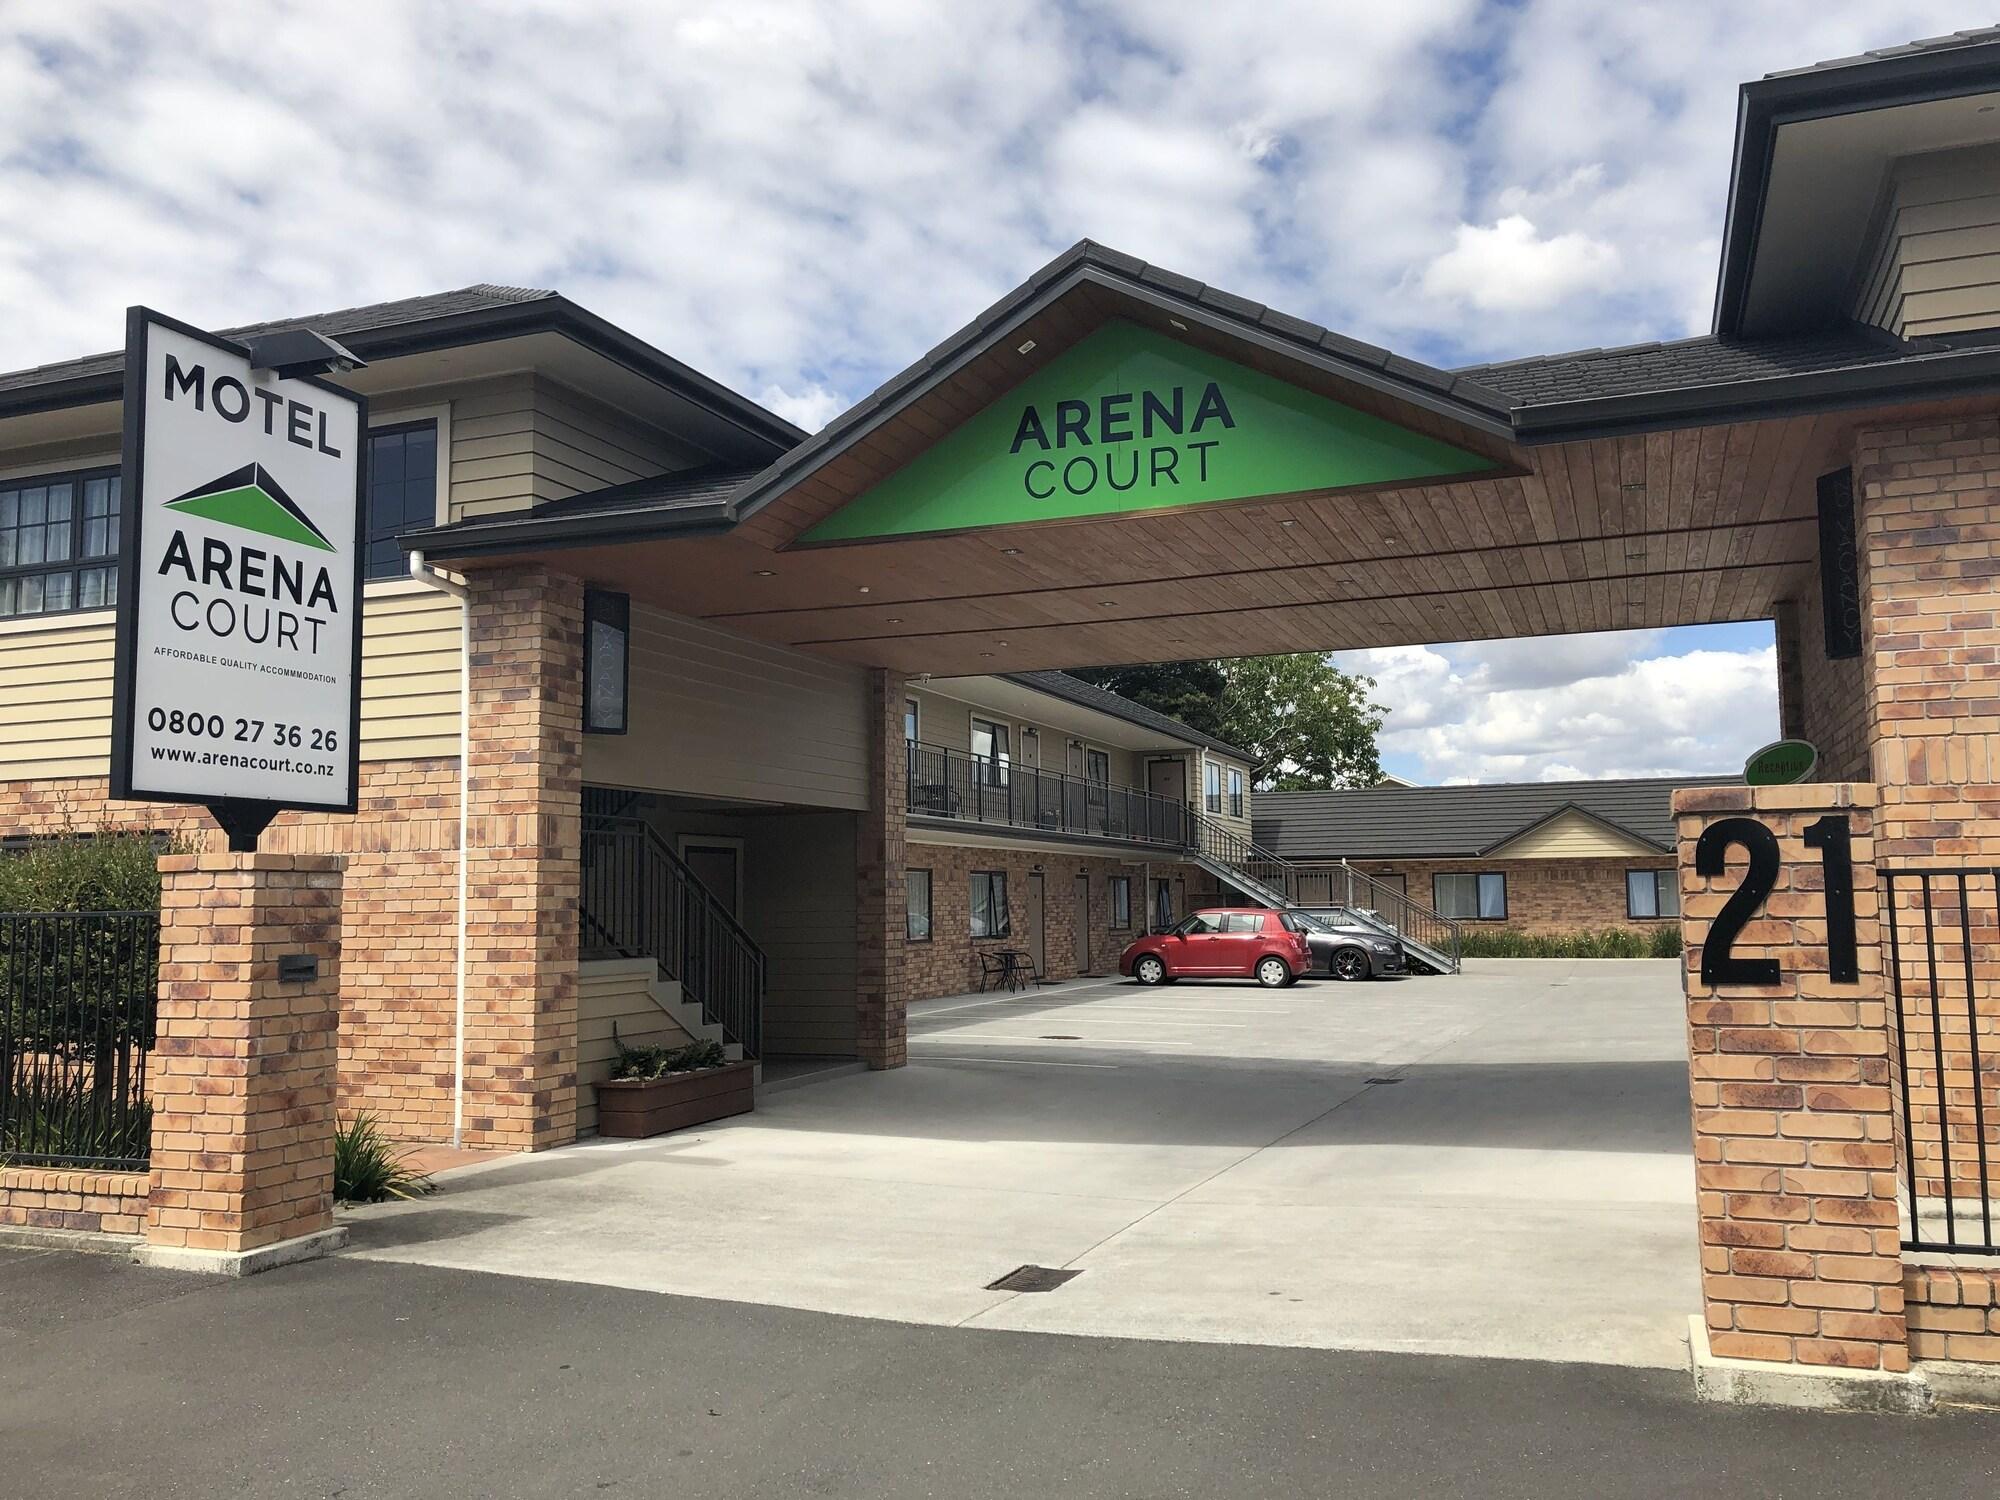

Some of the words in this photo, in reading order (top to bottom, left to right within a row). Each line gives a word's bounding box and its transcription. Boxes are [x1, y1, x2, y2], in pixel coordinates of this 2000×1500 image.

[164, 353, 341, 458] MOTEL
[1009, 382, 1236, 454] ARENA
[1024, 440, 1220, 499] COURT
[157, 529, 338, 614] ARENA
[170, 590, 327, 655] COURT
[153, 646, 218, 665] AFFORDABLE
[220, 657, 258, 671] QUALITY
[147, 707, 225, 739] 0800
[234, 718, 265, 743] 27
[273, 723, 302, 748] 36
[310, 728, 338, 752] 26
[150, 746, 335, 777] www.arenacourt.co.nz
[1695, 815, 1860, 986] 21
